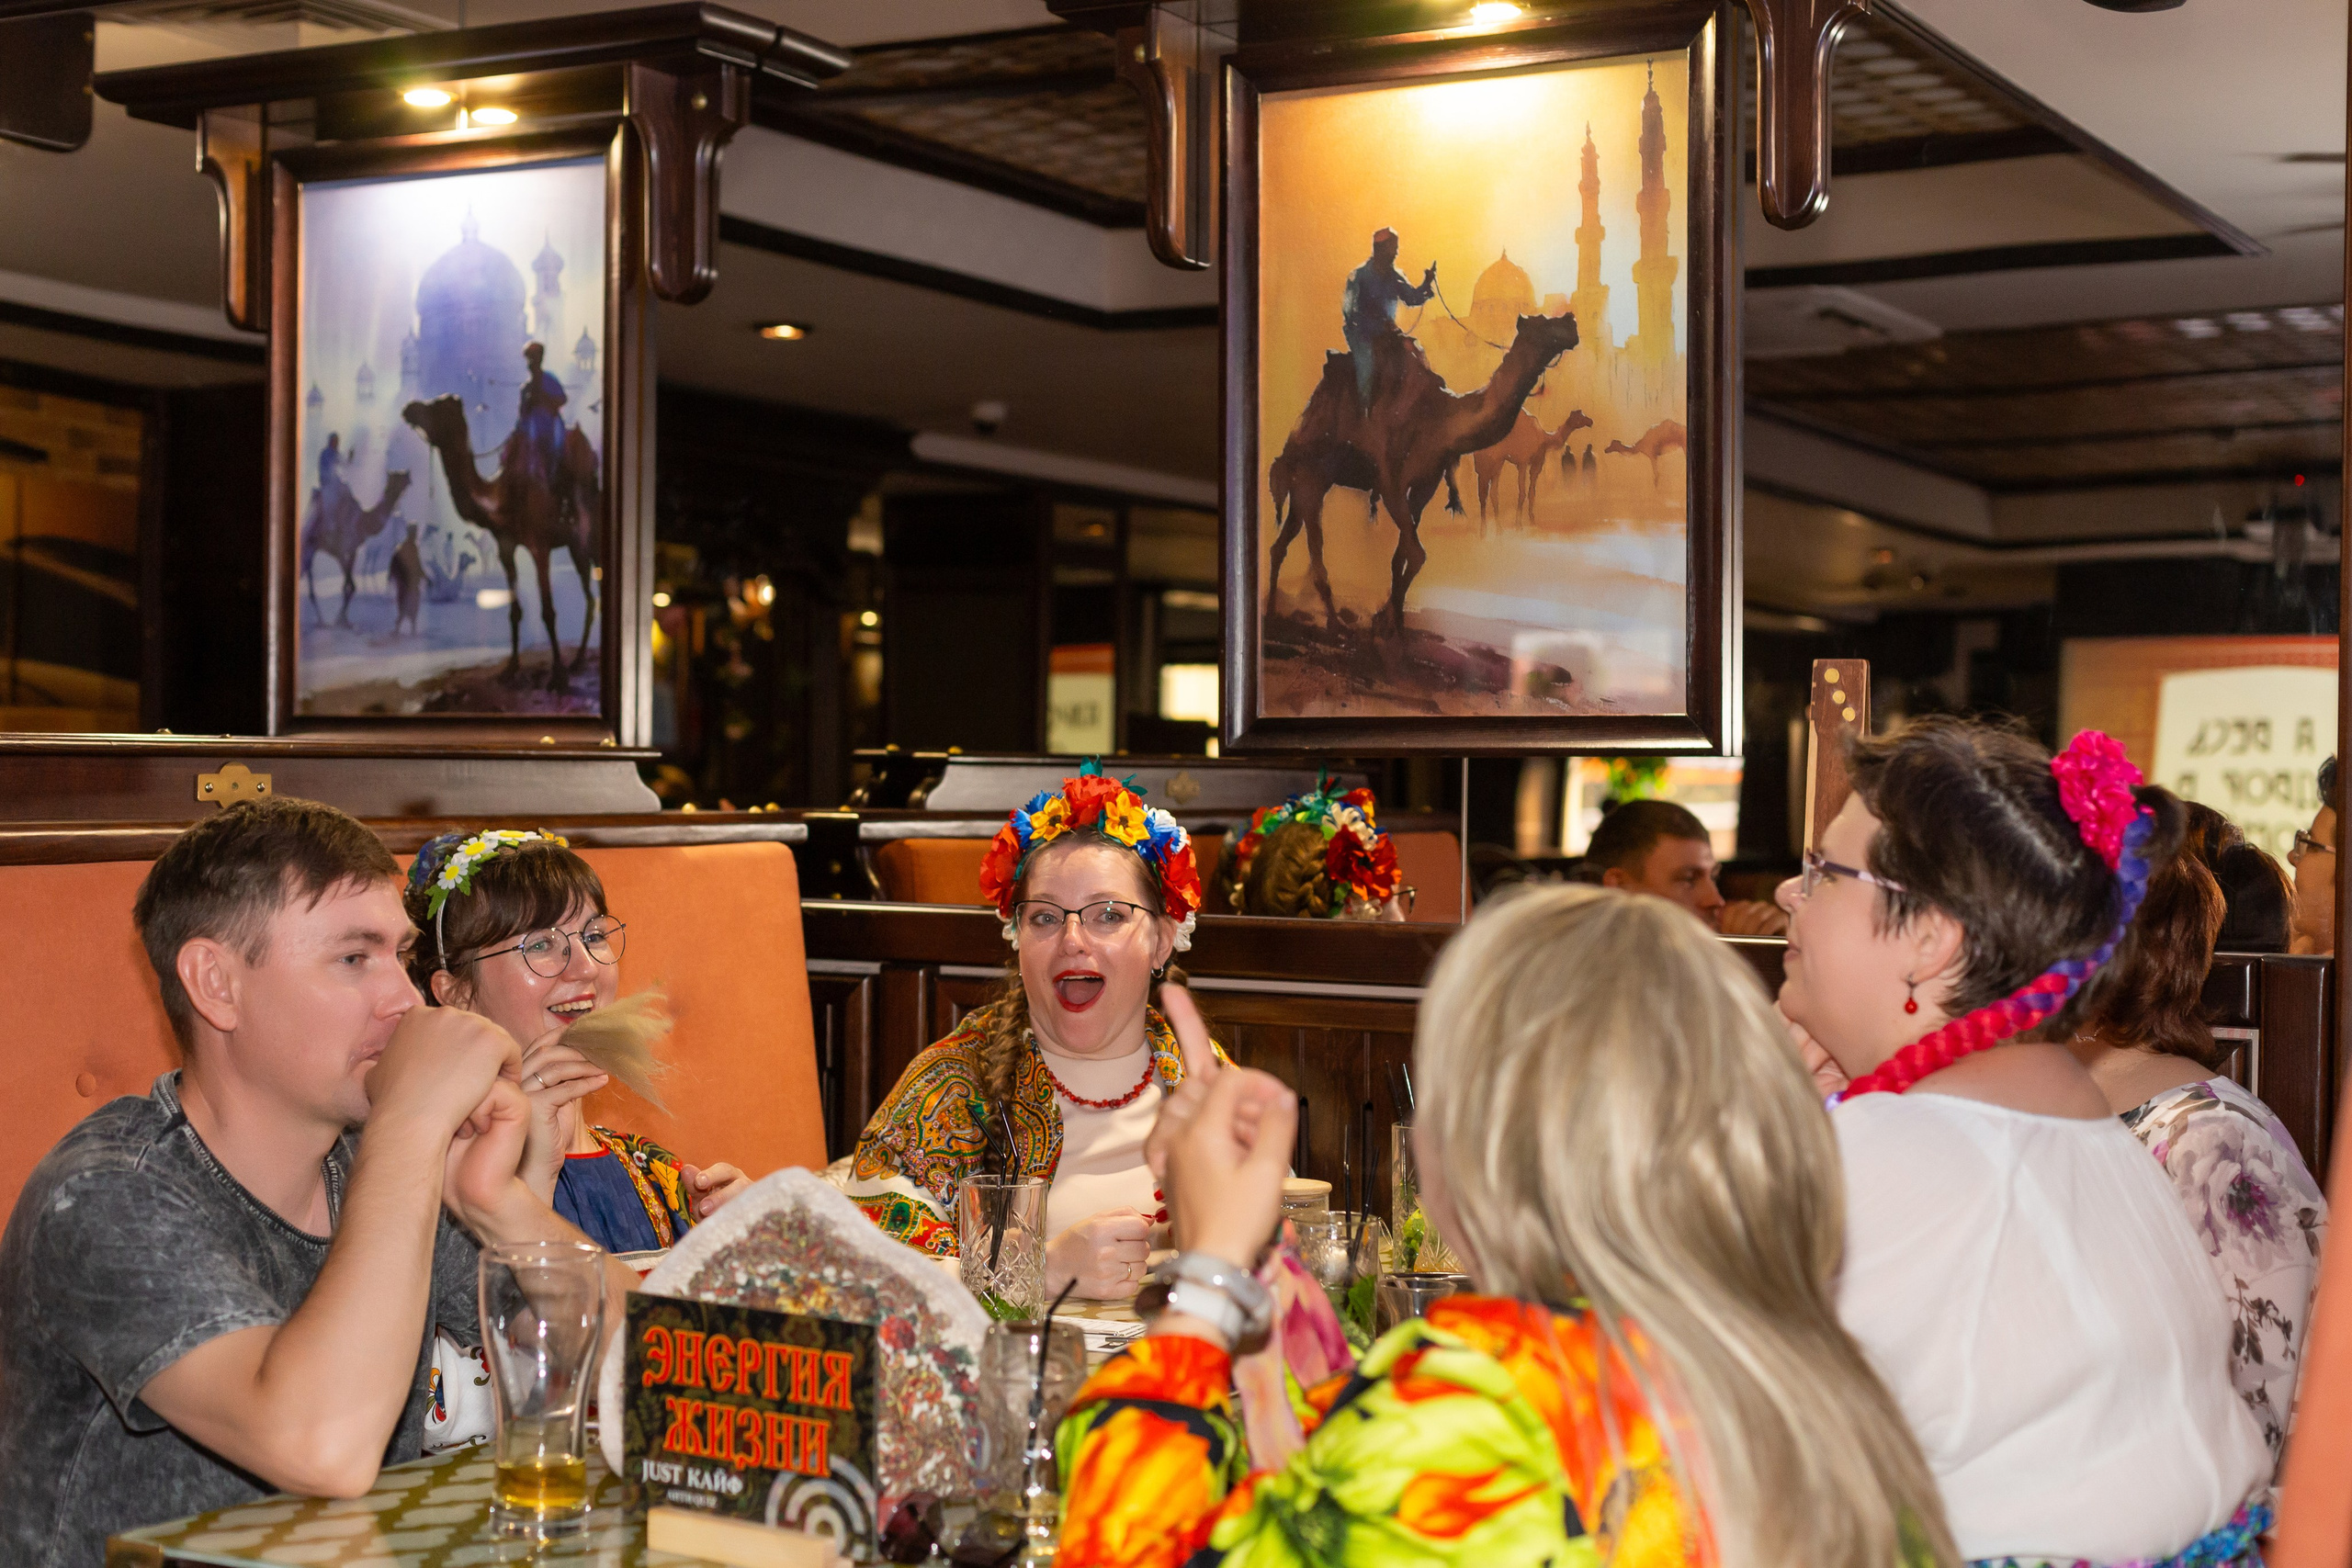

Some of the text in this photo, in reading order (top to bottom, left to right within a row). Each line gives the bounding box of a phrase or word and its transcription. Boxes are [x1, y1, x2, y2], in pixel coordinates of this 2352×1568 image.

[642, 1325, 854, 1411] ЭНЕРГИЯ
[641, 1458, 743, 1495] JUST КАЙФ
[662, 1394, 831, 1478] ЖИЗНИ
